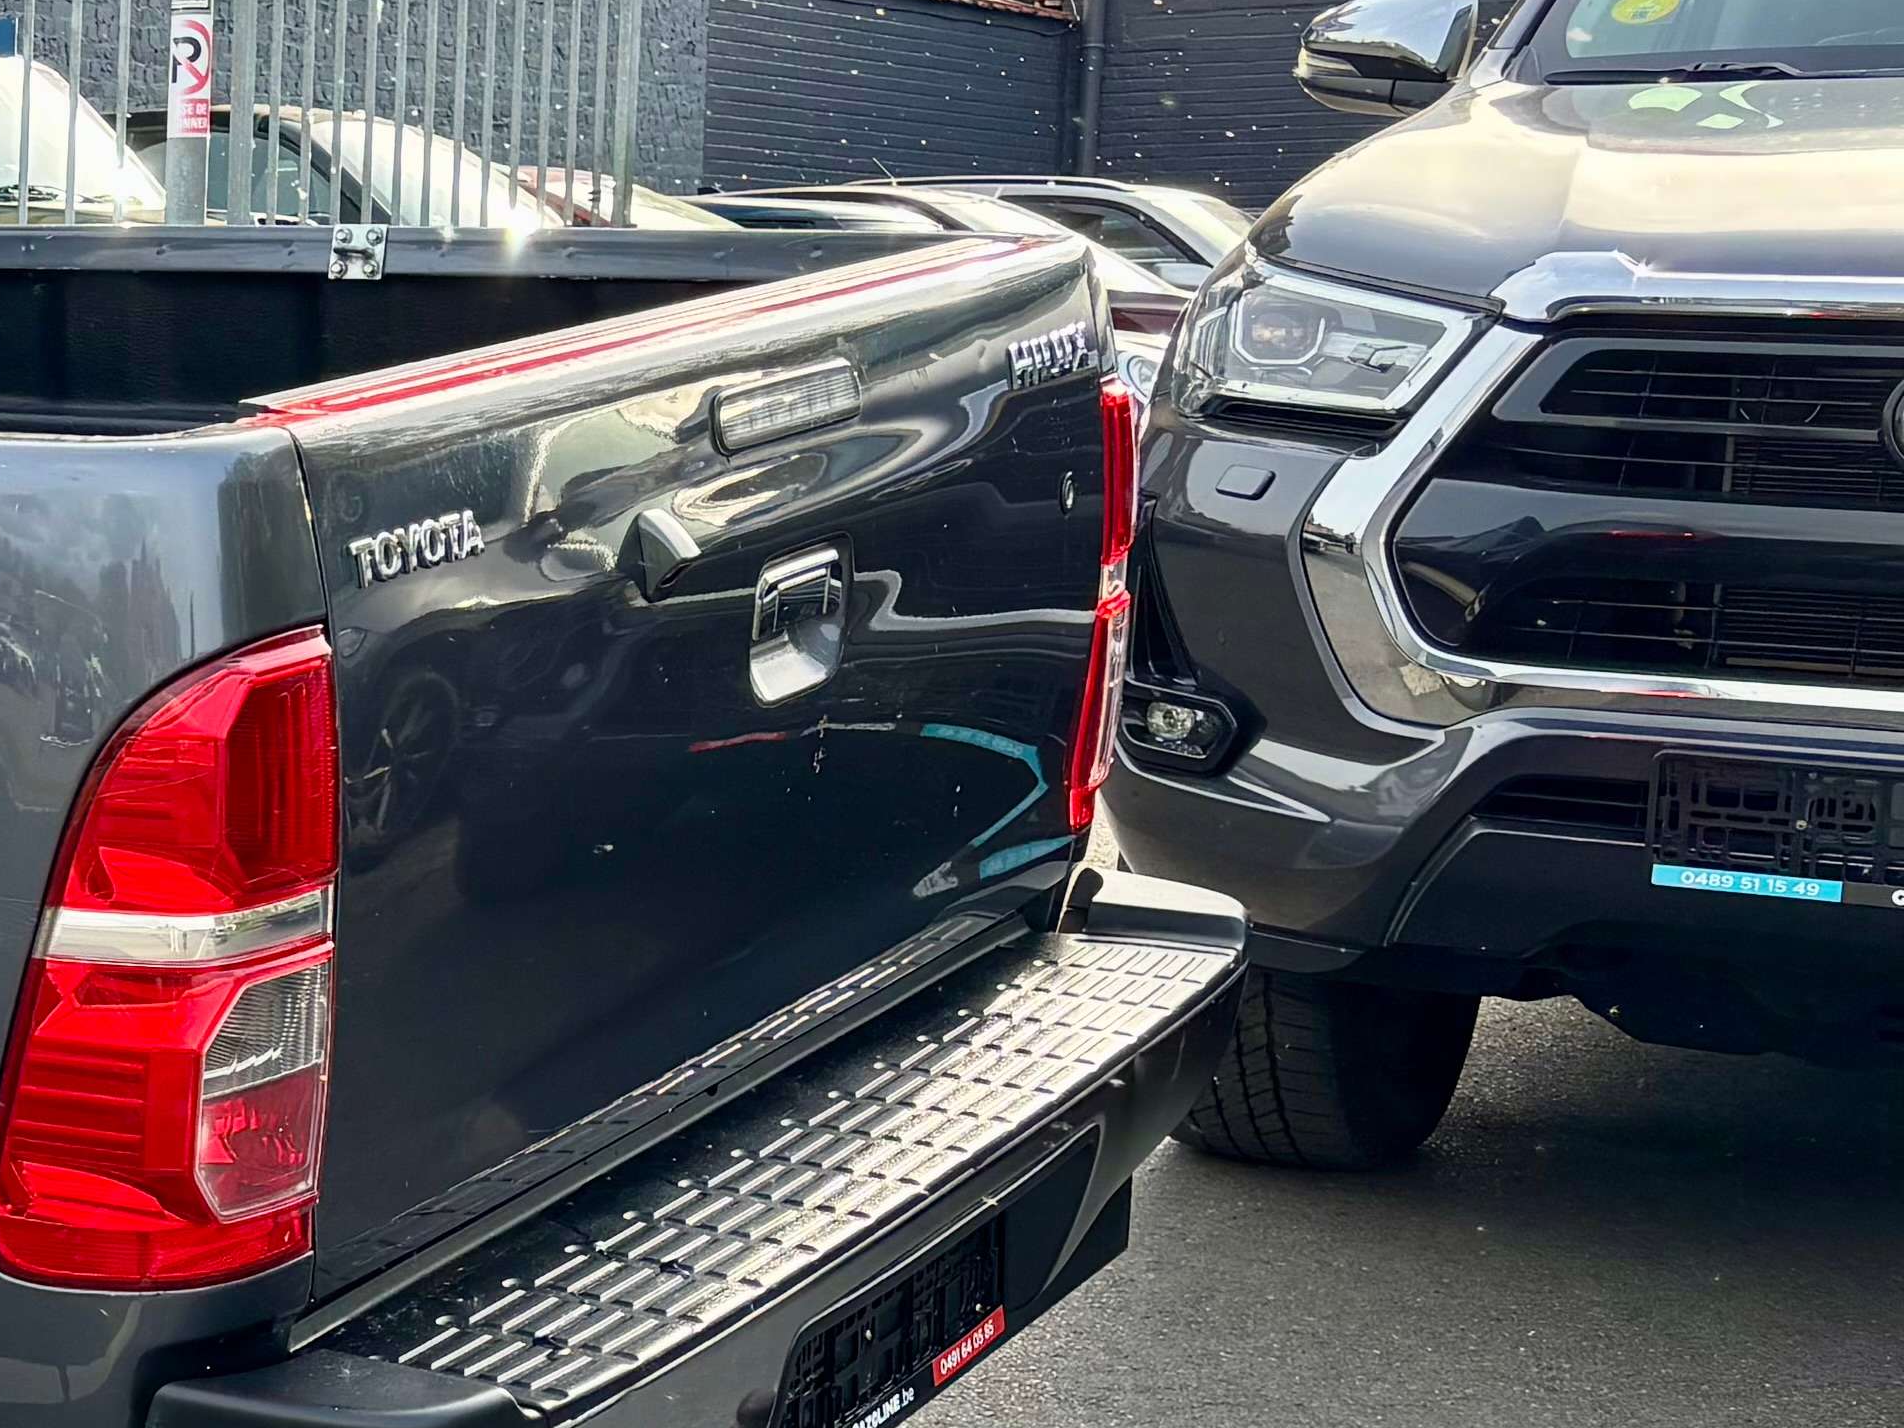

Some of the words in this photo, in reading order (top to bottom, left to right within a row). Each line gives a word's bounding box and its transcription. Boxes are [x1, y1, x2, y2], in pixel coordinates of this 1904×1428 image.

[1007, 320, 1089, 389] HILUX
[348, 509, 485, 588] TOYOTA
[1680, 870, 1734, 889] 0489
[1739, 875, 1760, 892] 51
[1766, 878, 1787, 893] 15
[1792, 881, 1820, 896] 49
[940, 1349, 961, 1375] 0491
